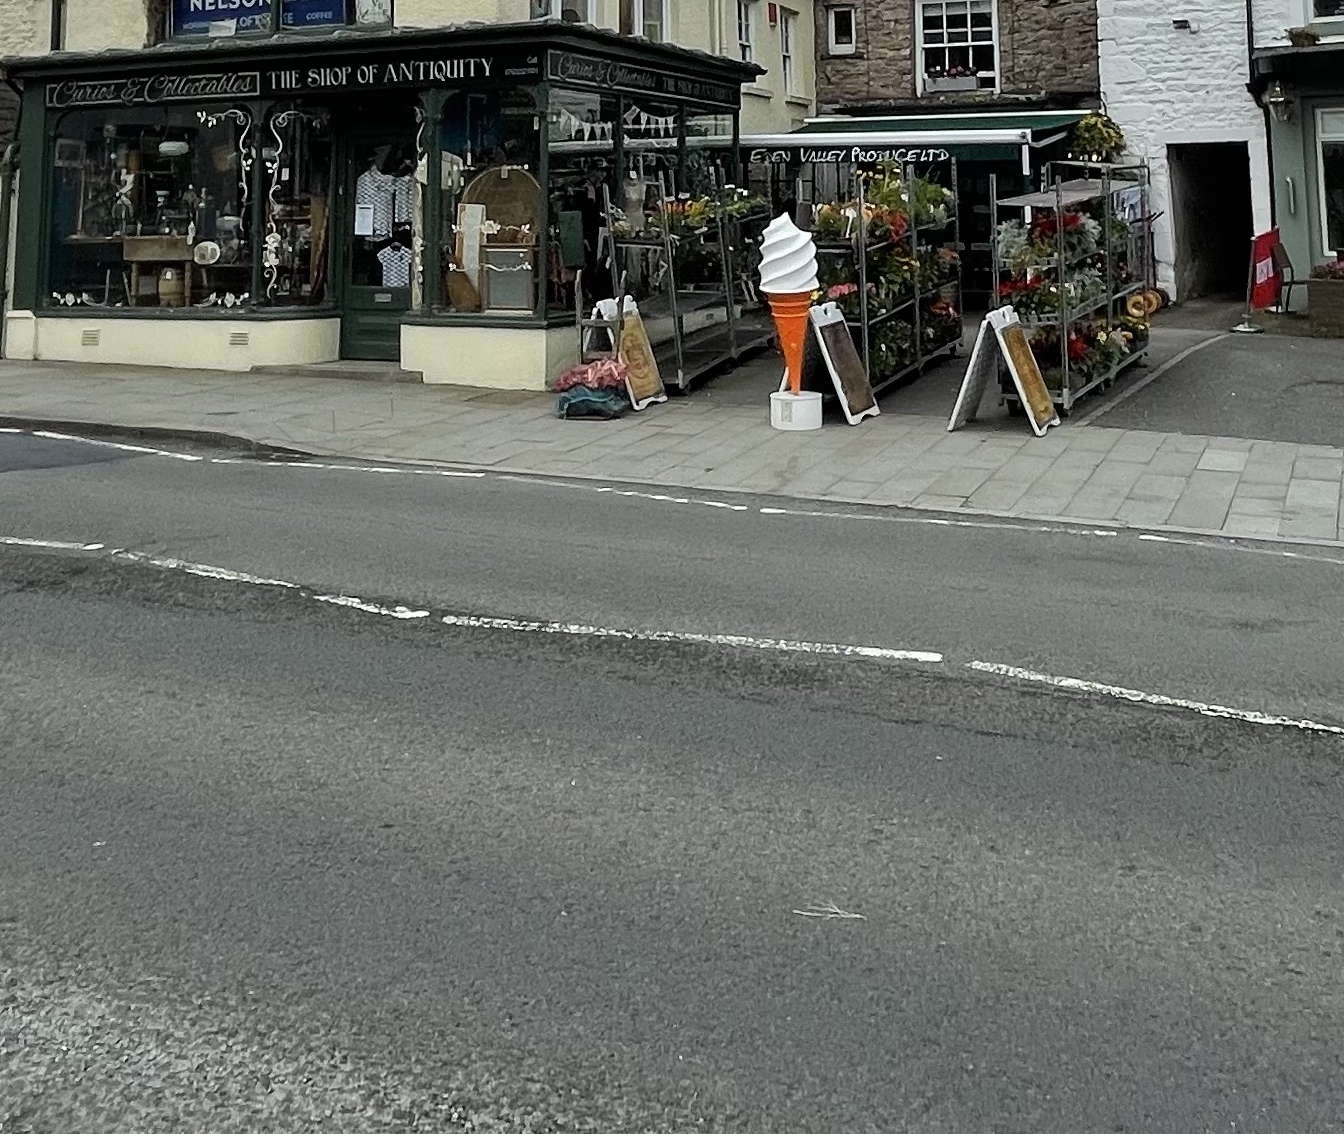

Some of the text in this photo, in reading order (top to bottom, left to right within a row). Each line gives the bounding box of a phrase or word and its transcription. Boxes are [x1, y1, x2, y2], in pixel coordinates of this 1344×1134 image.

[267, 70, 301, 90] THE
[307, 65, 351, 88] SHOP
[357, 65, 379, 84] OF
[383, 57, 493, 83] ANTIQUITY
[53, 73, 253, 108] Curios & Collectables
[800, 147, 847, 163] VALLEY
[919, 148, 950, 162] LTD
